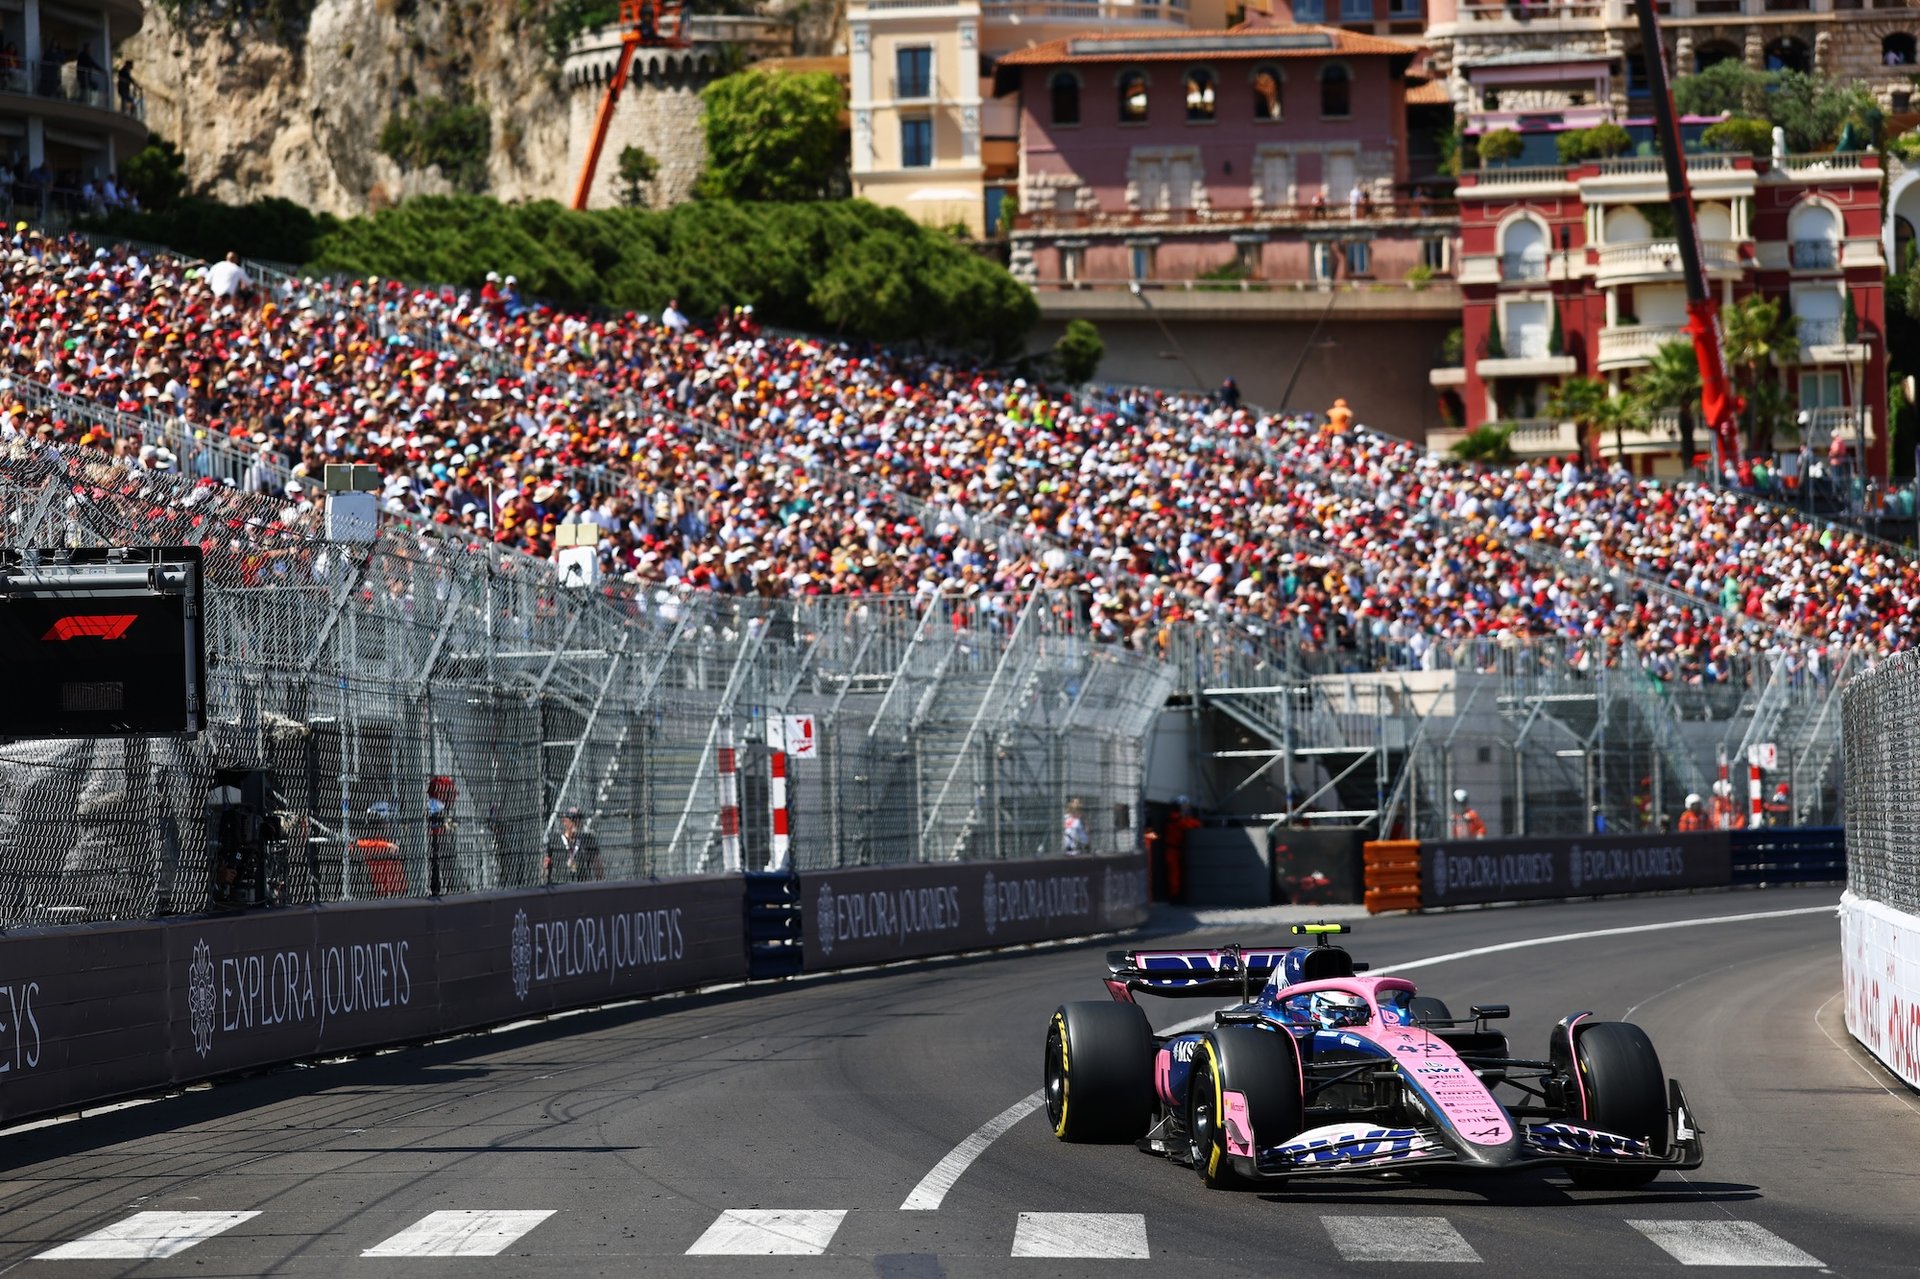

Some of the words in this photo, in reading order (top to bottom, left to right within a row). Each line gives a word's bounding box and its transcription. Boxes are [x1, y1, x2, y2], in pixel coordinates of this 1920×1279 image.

[1450, 855, 1498, 887] EXPLORA
[1584, 849, 1630, 881] EXPLORA
[836, 890, 898, 940] EXPLORA
[899, 885, 960, 944] JOURNEYS
[999, 879, 1043, 922] EXPLORA
[535, 917, 608, 981] EXPLORA
[610, 908, 683, 985] JOURNEYS
[222, 950, 316, 1032] EXPLORA
[319, 940, 410, 1038] JOURNEYS
[1396, 1043, 1442, 1053] 43
